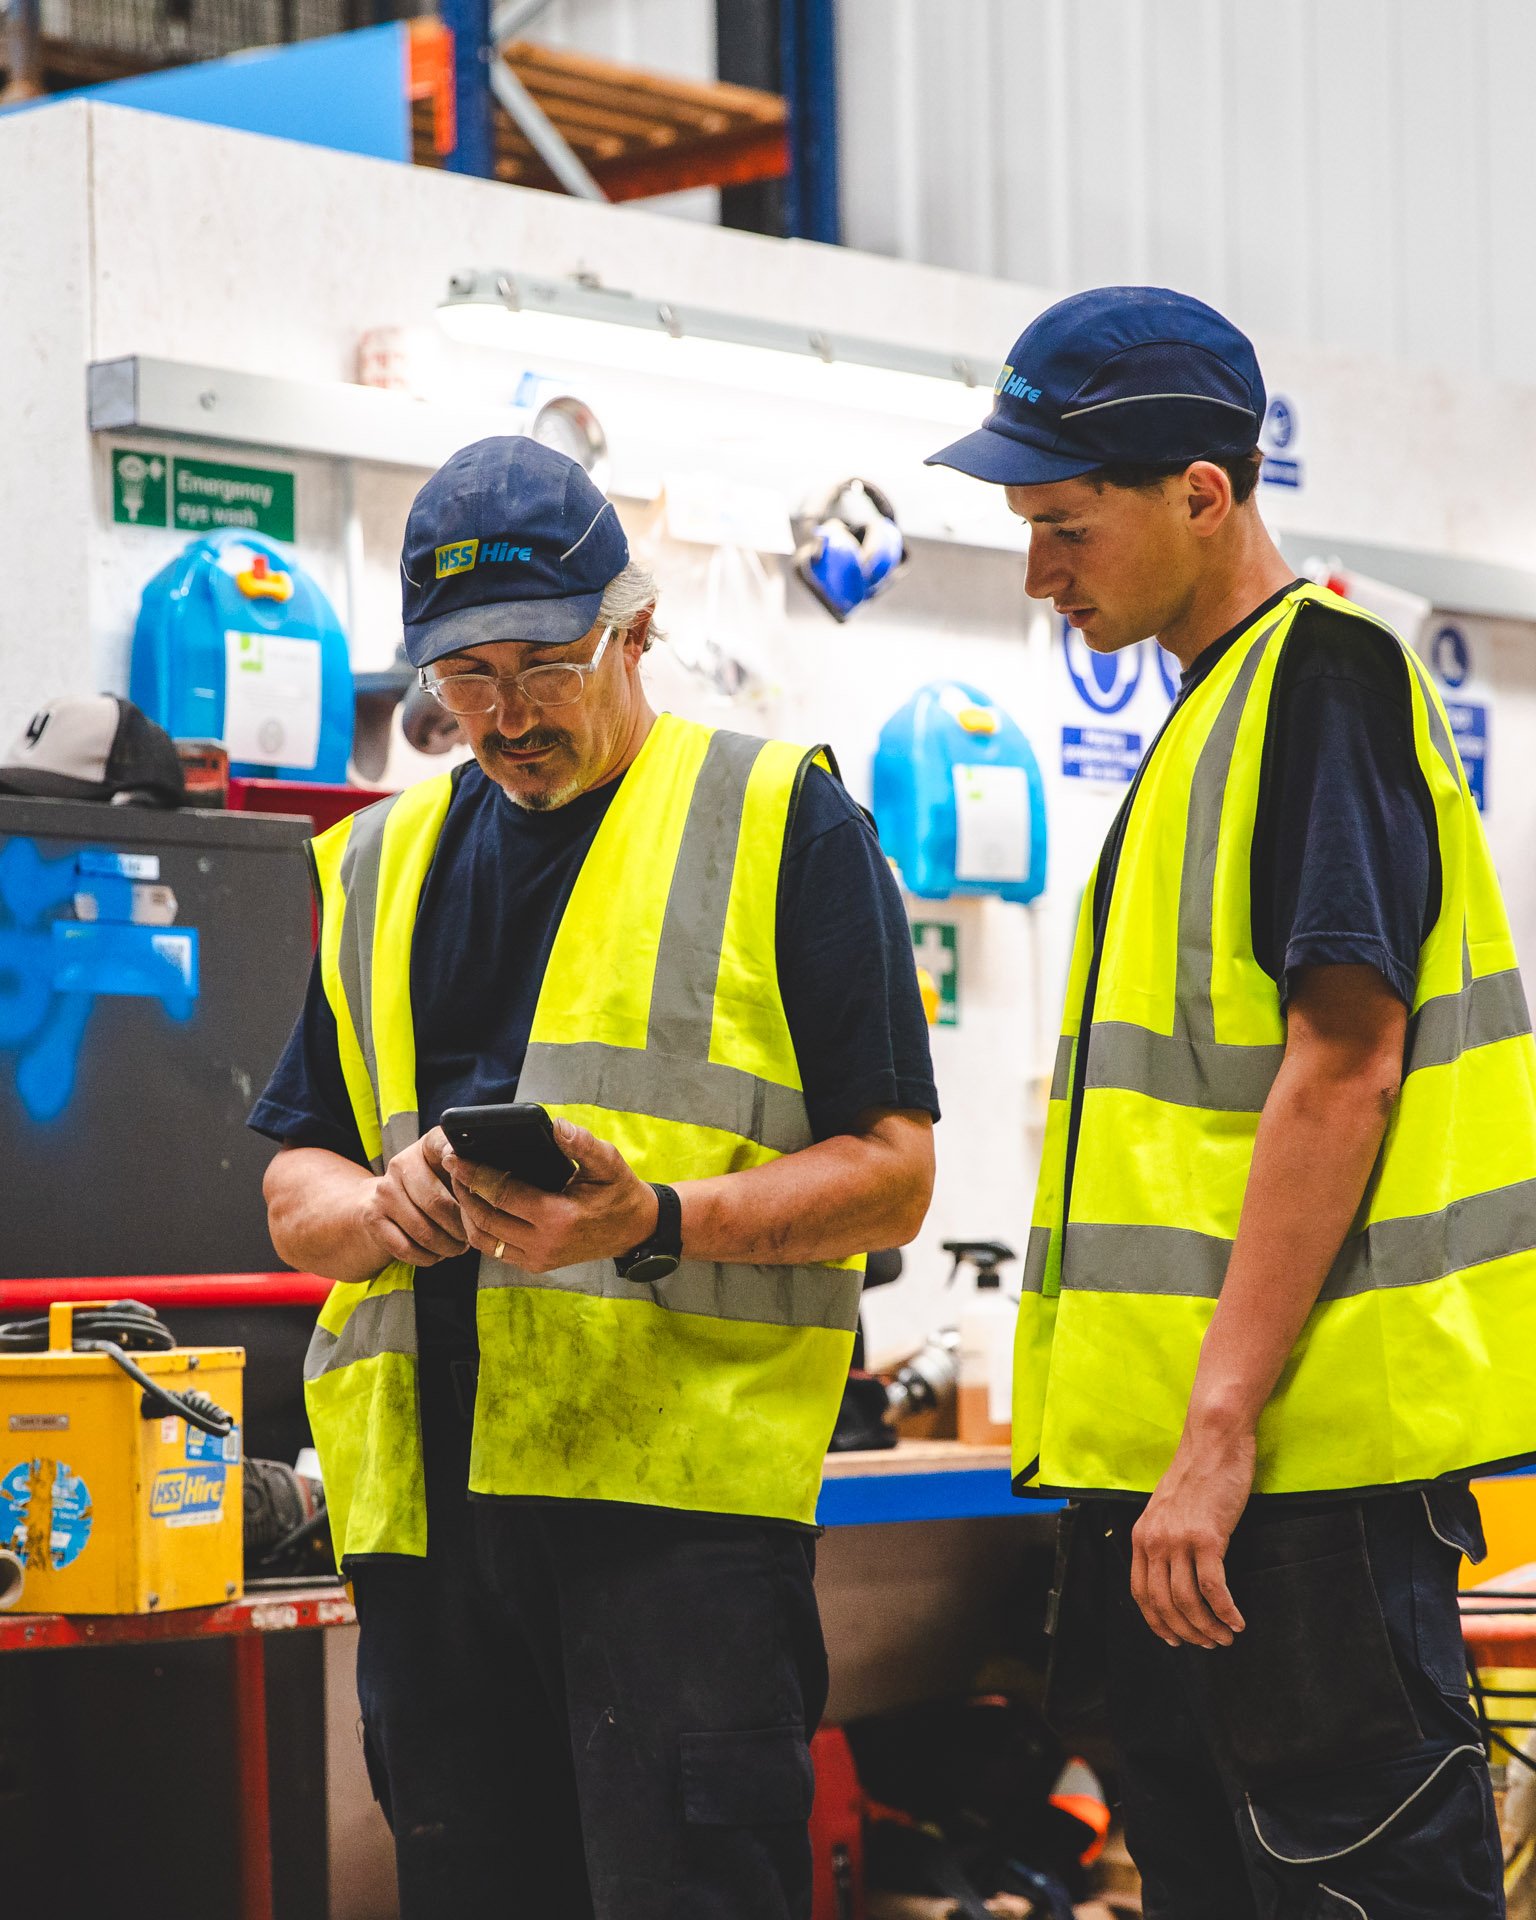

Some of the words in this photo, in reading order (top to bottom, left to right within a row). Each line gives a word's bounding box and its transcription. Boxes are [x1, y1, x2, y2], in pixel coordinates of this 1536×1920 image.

[1003, 373, 1042, 403] Hire
[176, 469, 275, 509] Emergency
[439, 545, 474, 571] HSS
[479, 542, 532, 563] Hire
[156, 1480, 182, 1504] HSS
[184, 1475, 224, 1505] Hire
